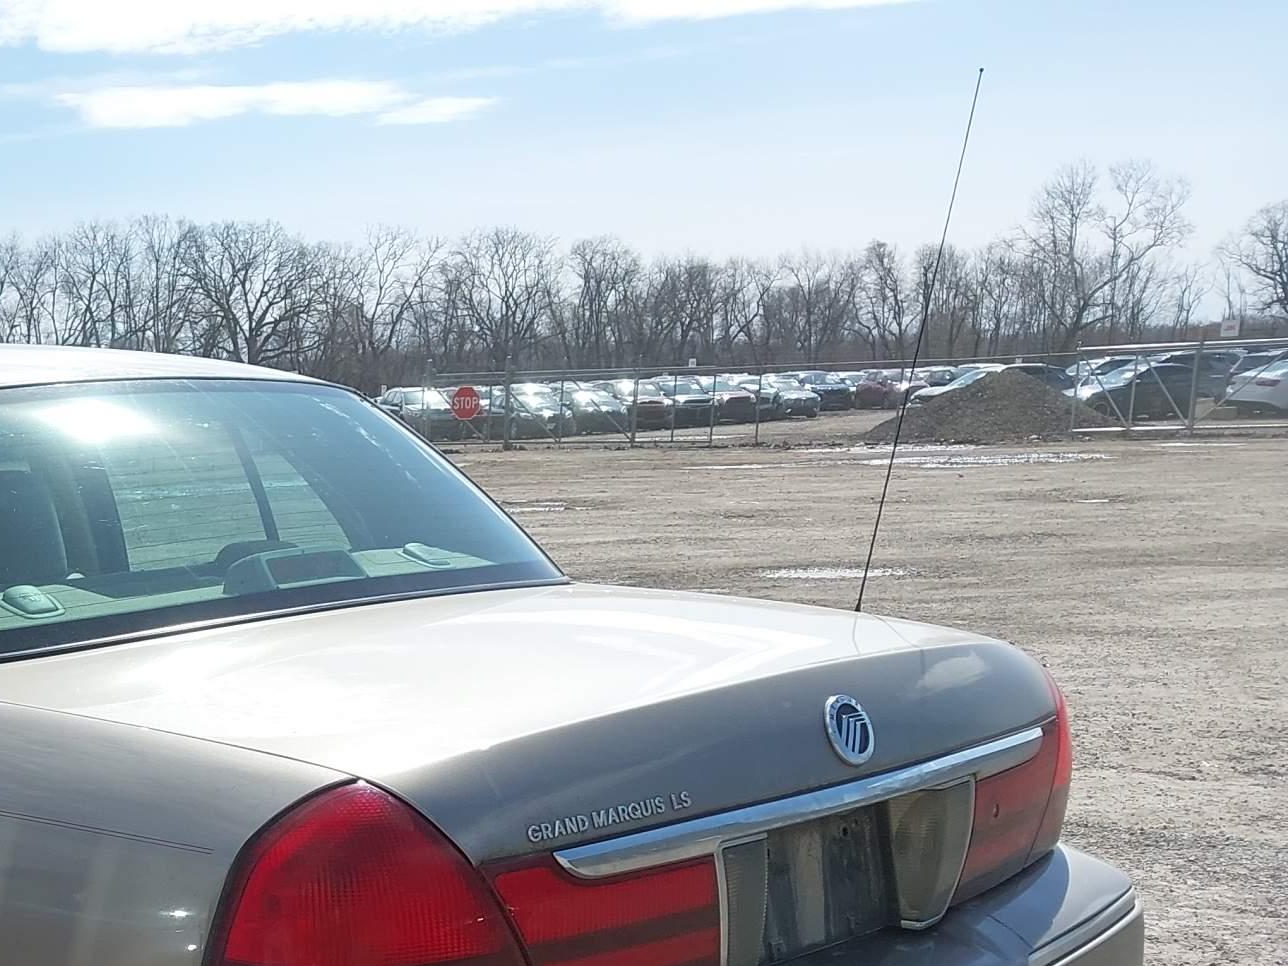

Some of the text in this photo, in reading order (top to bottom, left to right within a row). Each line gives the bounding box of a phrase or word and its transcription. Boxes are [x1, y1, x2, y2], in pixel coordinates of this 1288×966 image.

[453, 396, 479, 410] STOP
[527, 791, 692, 842] GRAND MARQUIS LS
